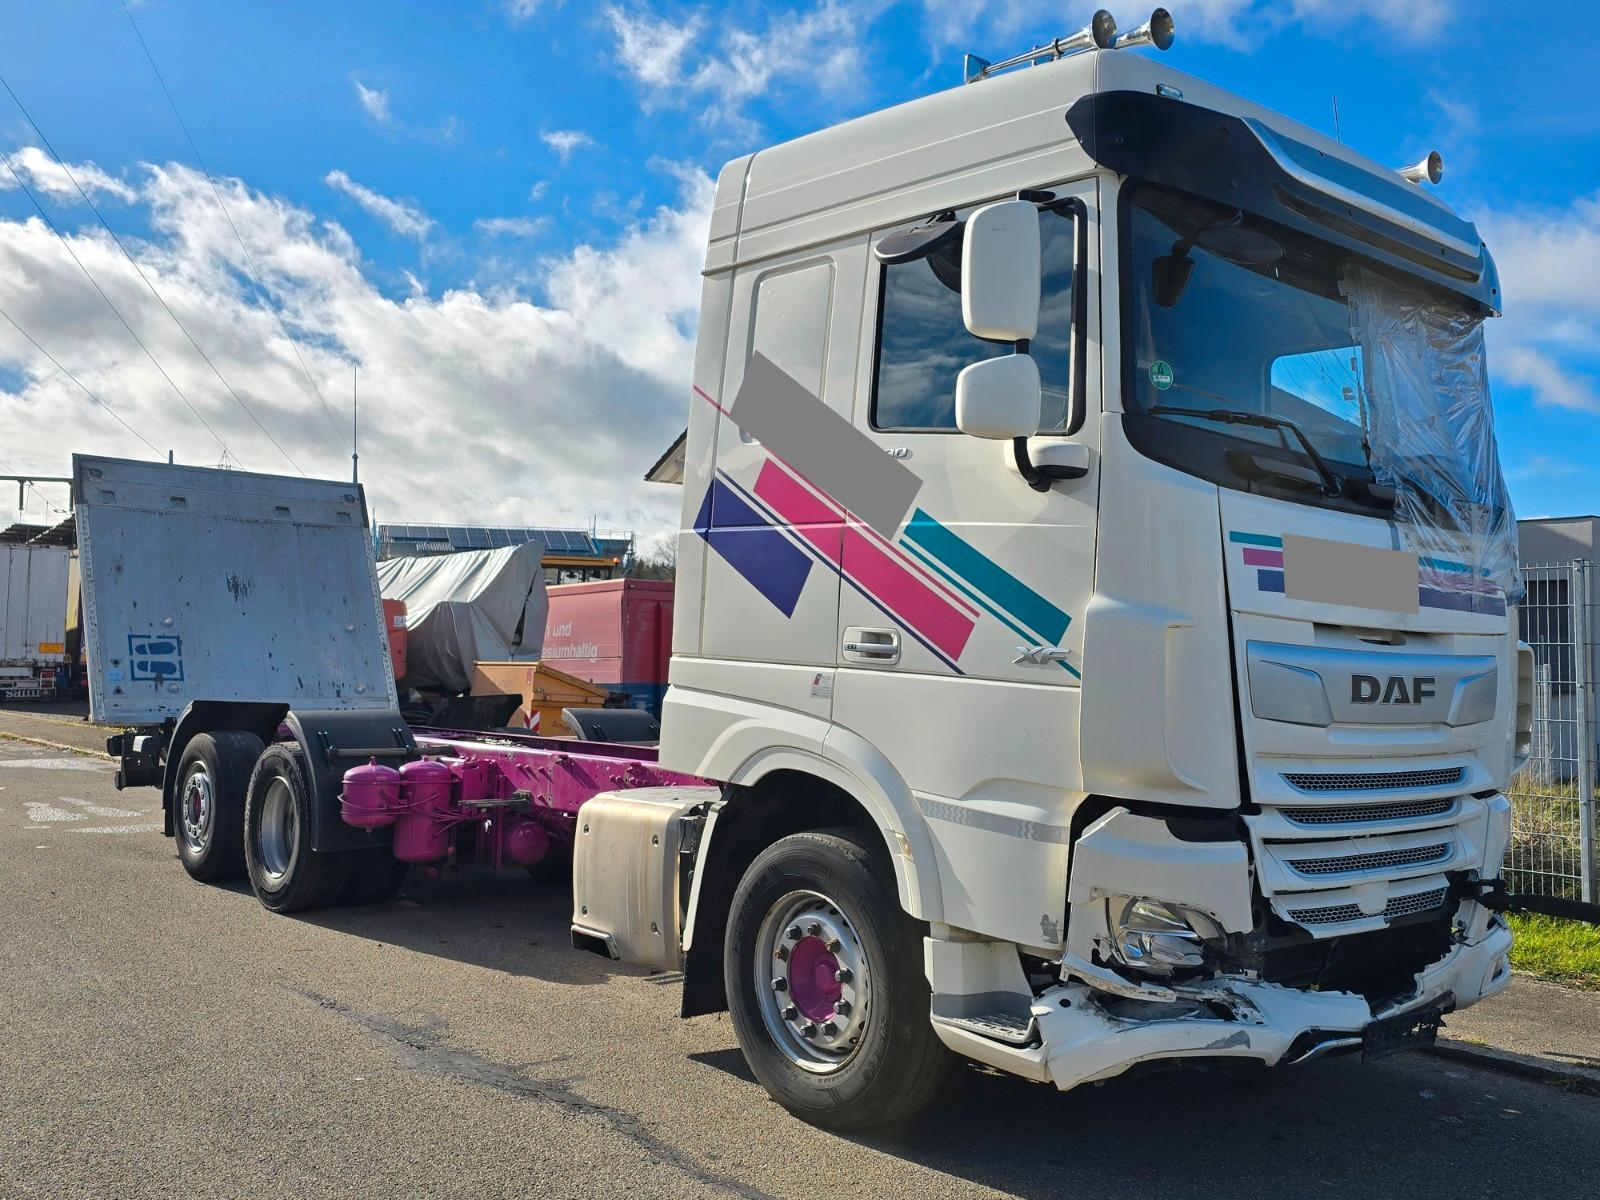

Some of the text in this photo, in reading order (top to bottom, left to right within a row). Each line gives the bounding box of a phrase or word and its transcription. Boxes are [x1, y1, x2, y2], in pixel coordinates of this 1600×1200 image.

[552, 620, 572, 637] und
[541, 642, 598, 663] esiumhaltig
[1011, 645, 1072, 665] XF
[1350, 673, 1436, 705] DAF
